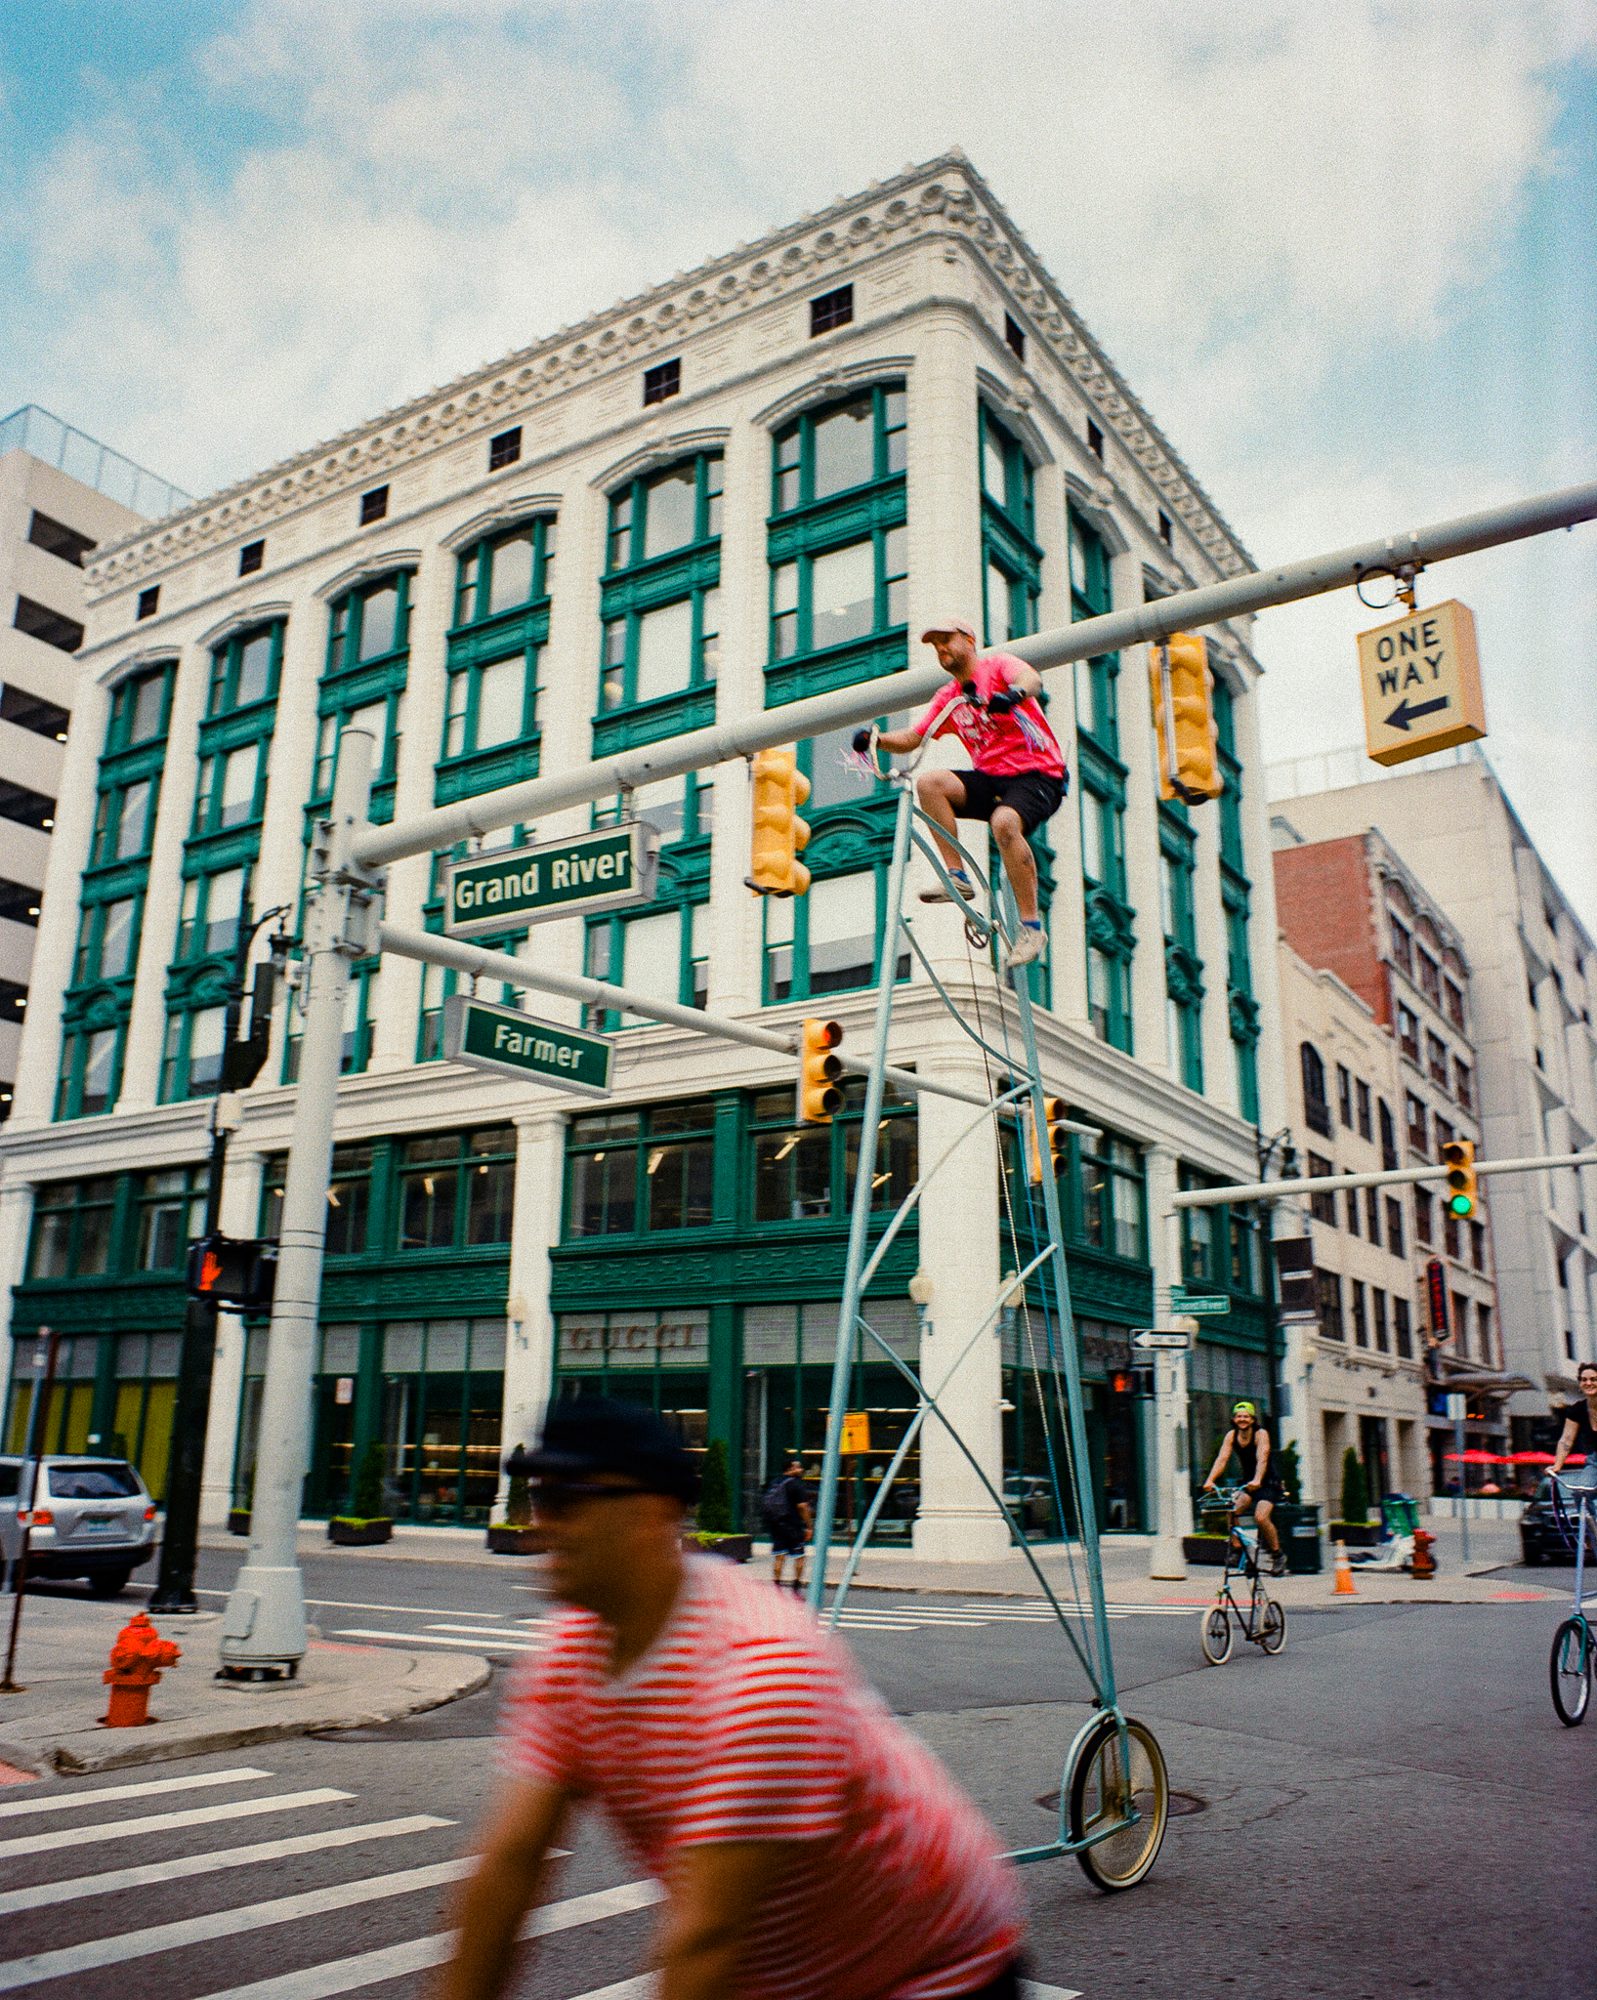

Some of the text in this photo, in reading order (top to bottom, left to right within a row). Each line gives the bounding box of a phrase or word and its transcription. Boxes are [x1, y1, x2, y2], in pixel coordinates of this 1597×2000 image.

[1377, 619, 1440, 663] ONE
[1377, 651, 1444, 697] WAY
[455, 849, 629, 908] Grand River
[494, 1025, 584, 1069] Farmer
[570, 1324, 693, 1353] GUCCI
